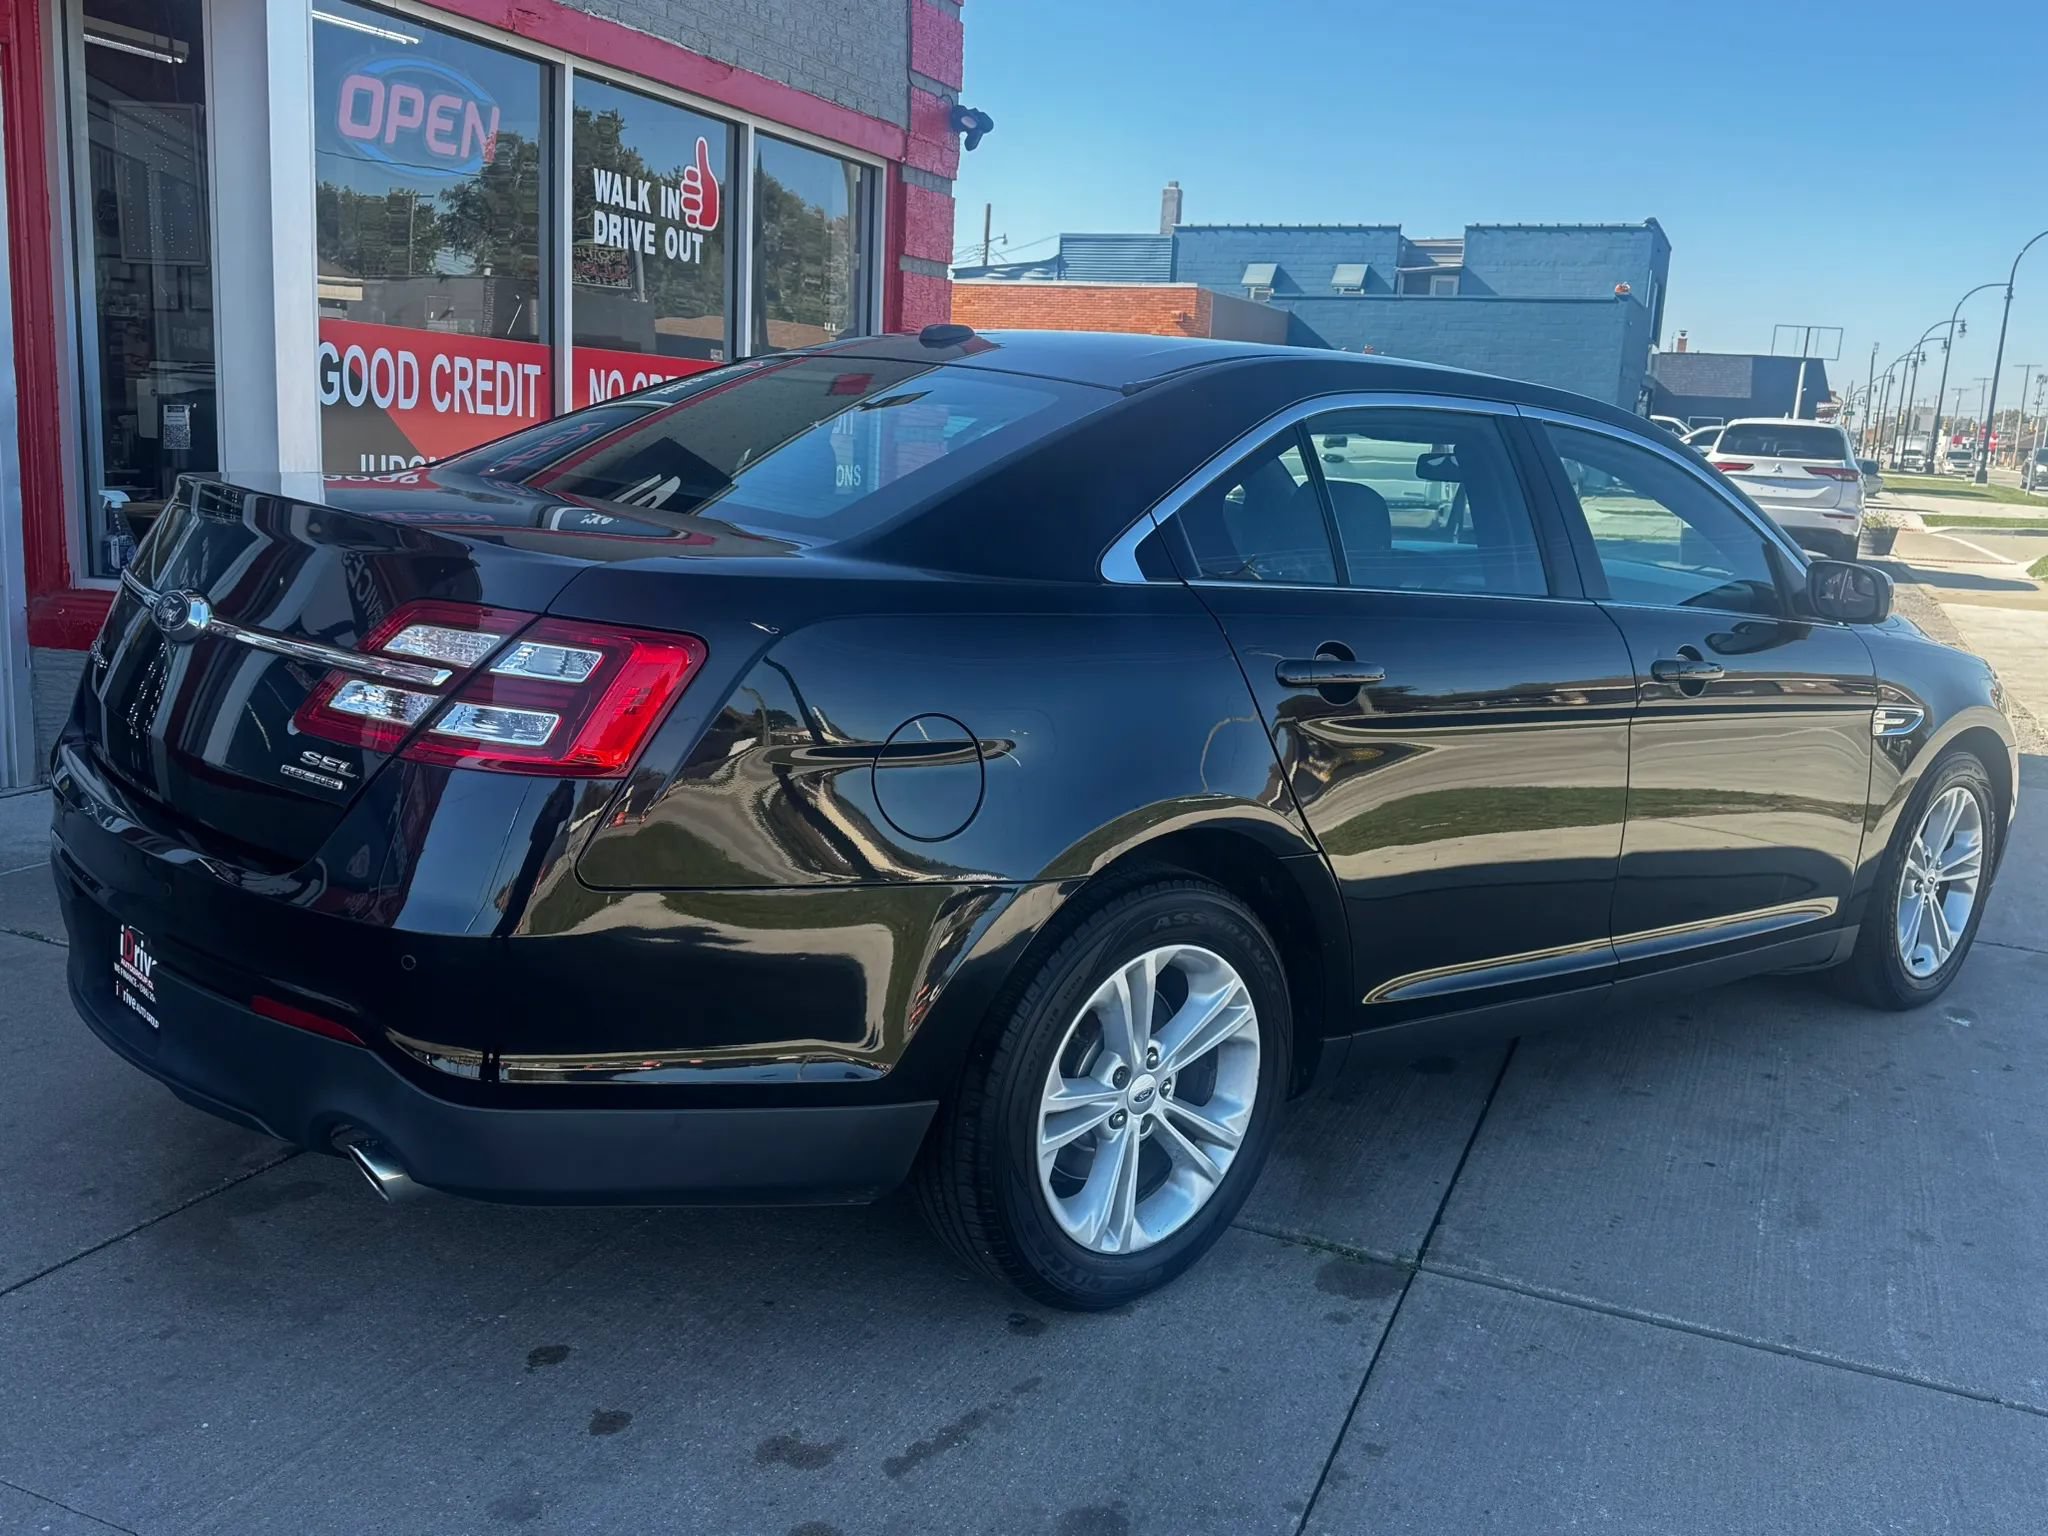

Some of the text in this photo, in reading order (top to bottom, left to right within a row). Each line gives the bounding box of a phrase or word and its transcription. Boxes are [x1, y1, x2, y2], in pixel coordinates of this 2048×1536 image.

[339, 75, 500, 164] OPEN
[594, 168, 680, 220] WALK IN
[594, 210, 703, 264] DRIVE OUT
[319, 341, 541, 418] GOOD CREDIT
[590, 368, 625, 405] NO
[157, 596, 183, 622] Ford
[282, 765, 339, 788] FLEX FUEL
[300, 751, 357, 777] SEL
